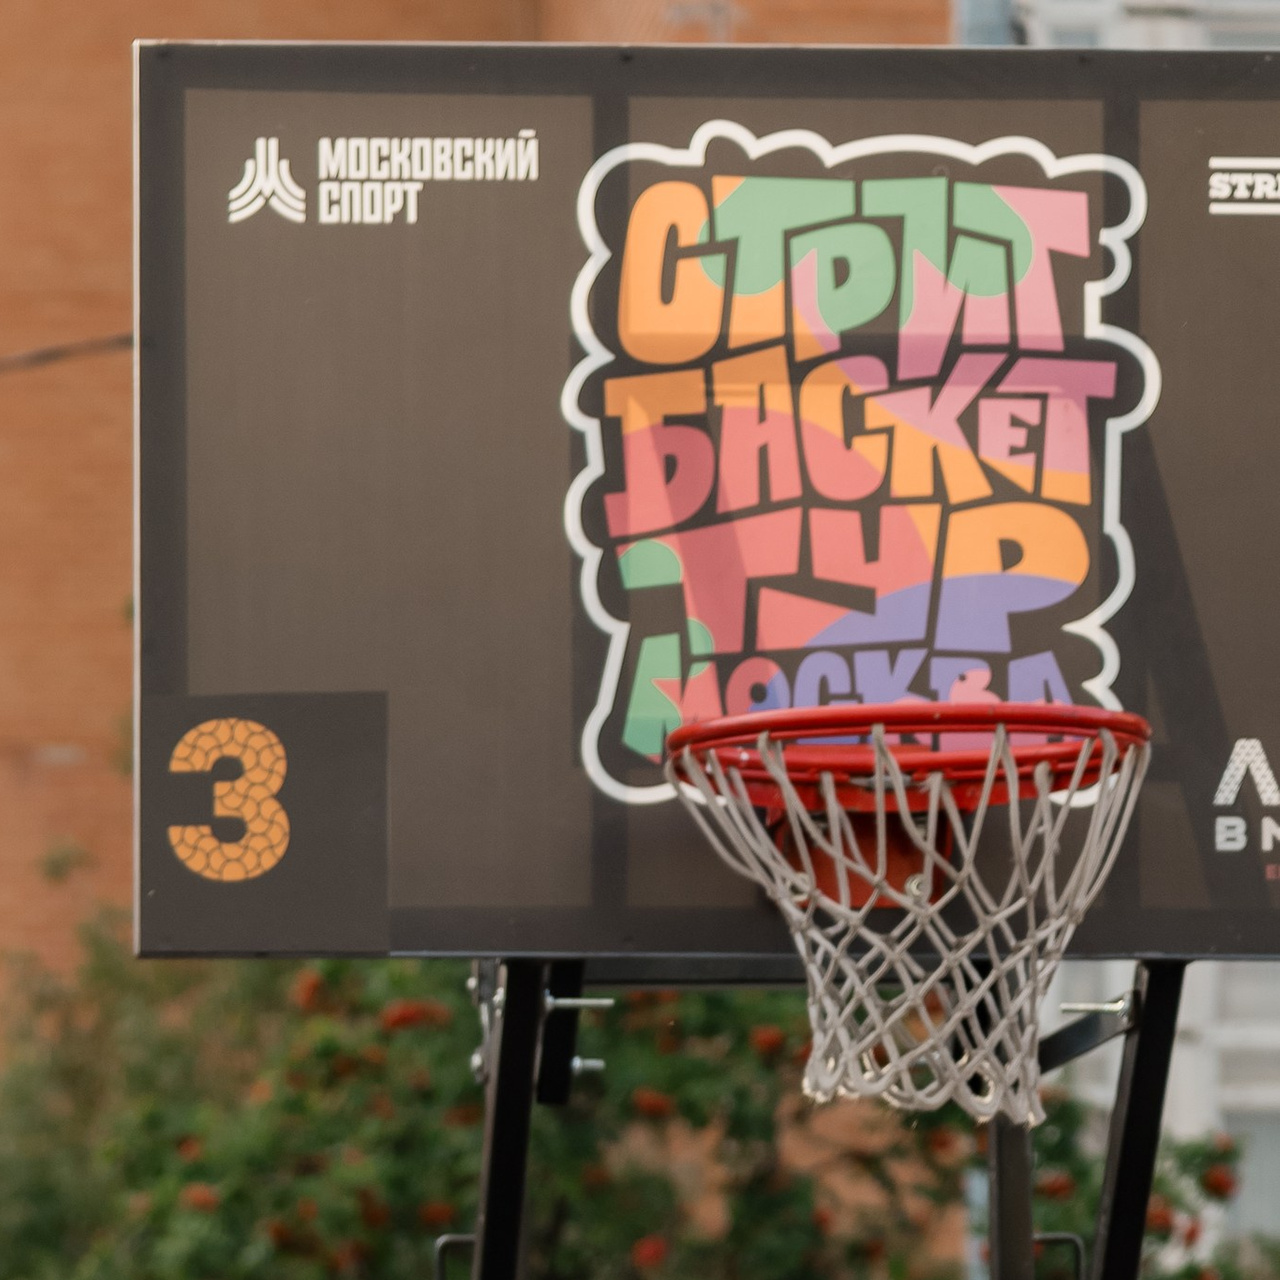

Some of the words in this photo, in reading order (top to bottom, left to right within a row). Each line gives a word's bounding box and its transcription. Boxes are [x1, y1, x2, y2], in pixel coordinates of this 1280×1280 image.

[318, 129, 539, 180] МОСКОВСКИЙ
[318, 181, 424, 224] СПОРТ
[619, 175, 1091, 382] СТРИТ
[604, 344, 1118, 538] БАСКЕТ
[616, 501, 1091, 656] ТУР
[622, 632, 1082, 764] МОСКВА
[167, 717, 290, 882] 3
